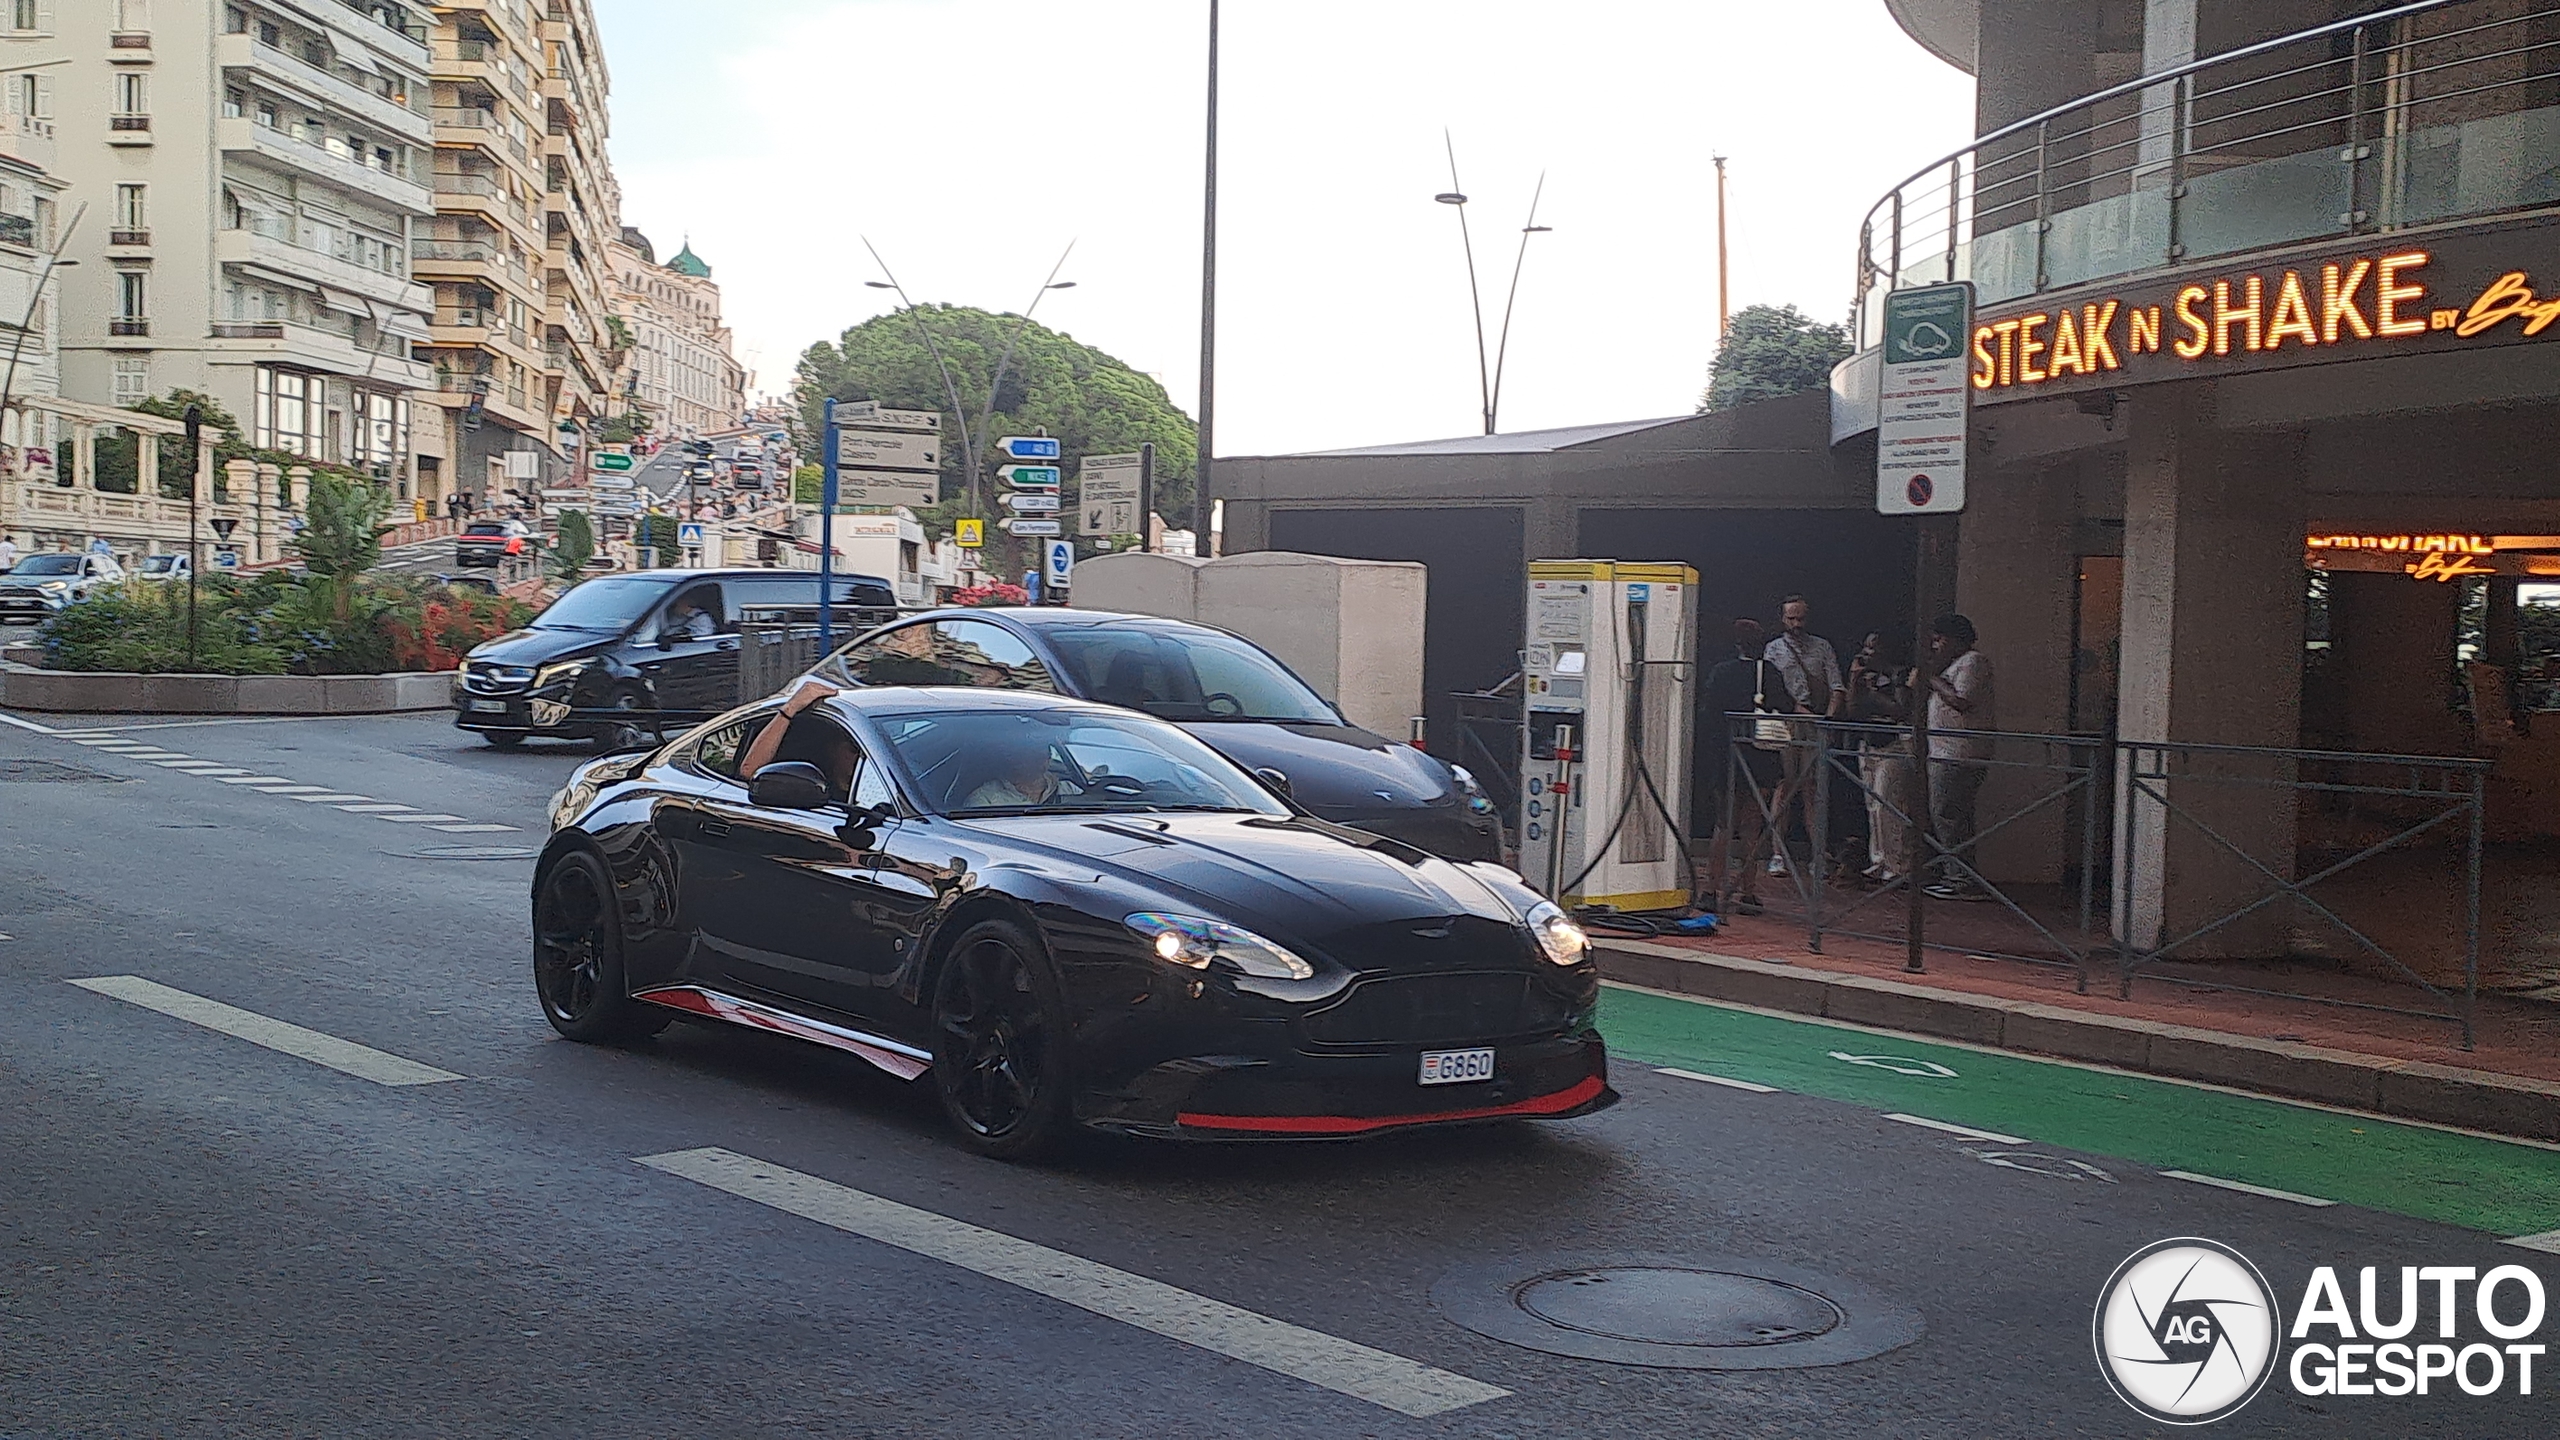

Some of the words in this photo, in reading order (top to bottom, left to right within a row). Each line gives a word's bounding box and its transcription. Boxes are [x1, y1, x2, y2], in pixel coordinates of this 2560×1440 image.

[1972, 299, 2121, 391] STEAK
[2128, 305, 2161, 354] N
[2174, 250, 2429, 361] SHAKE
[2431, 308, 2460, 330] BY
[1440, 1052, 1490, 1079] G860
